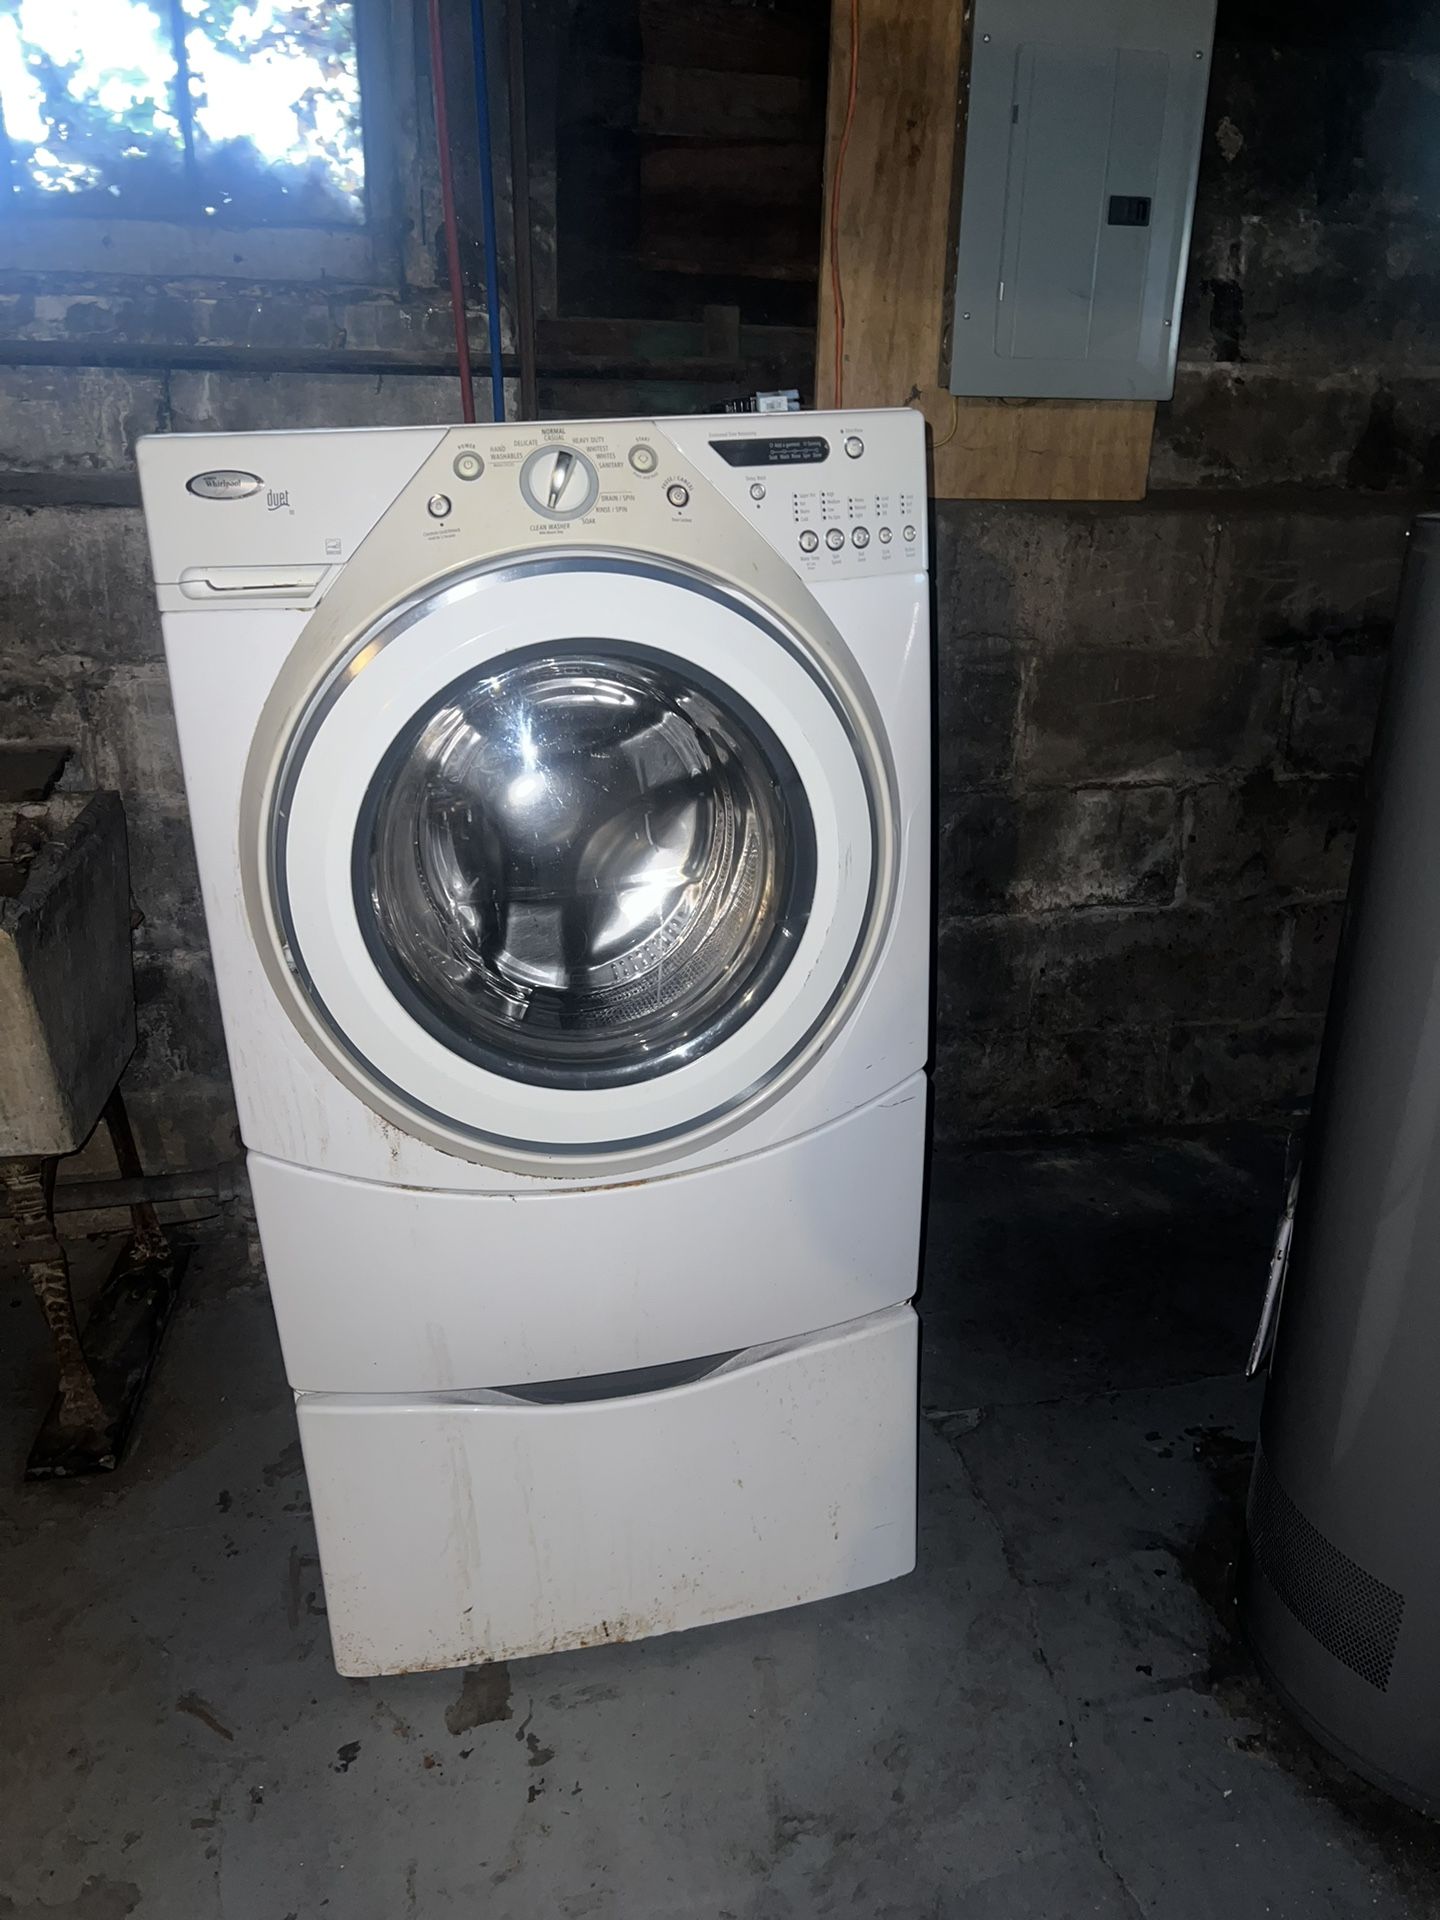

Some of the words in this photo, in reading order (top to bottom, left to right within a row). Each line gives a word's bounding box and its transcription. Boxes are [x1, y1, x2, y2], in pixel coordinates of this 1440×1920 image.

[598, 461, 624, 469] SANITARY
[204, 479, 242, 488] Whirlpool
[266, 489, 290, 508] duet
[615, 505, 628, 513] SPIN
[529, 524, 547, 532] CLEAN
[548, 522, 570, 530] WASHER
